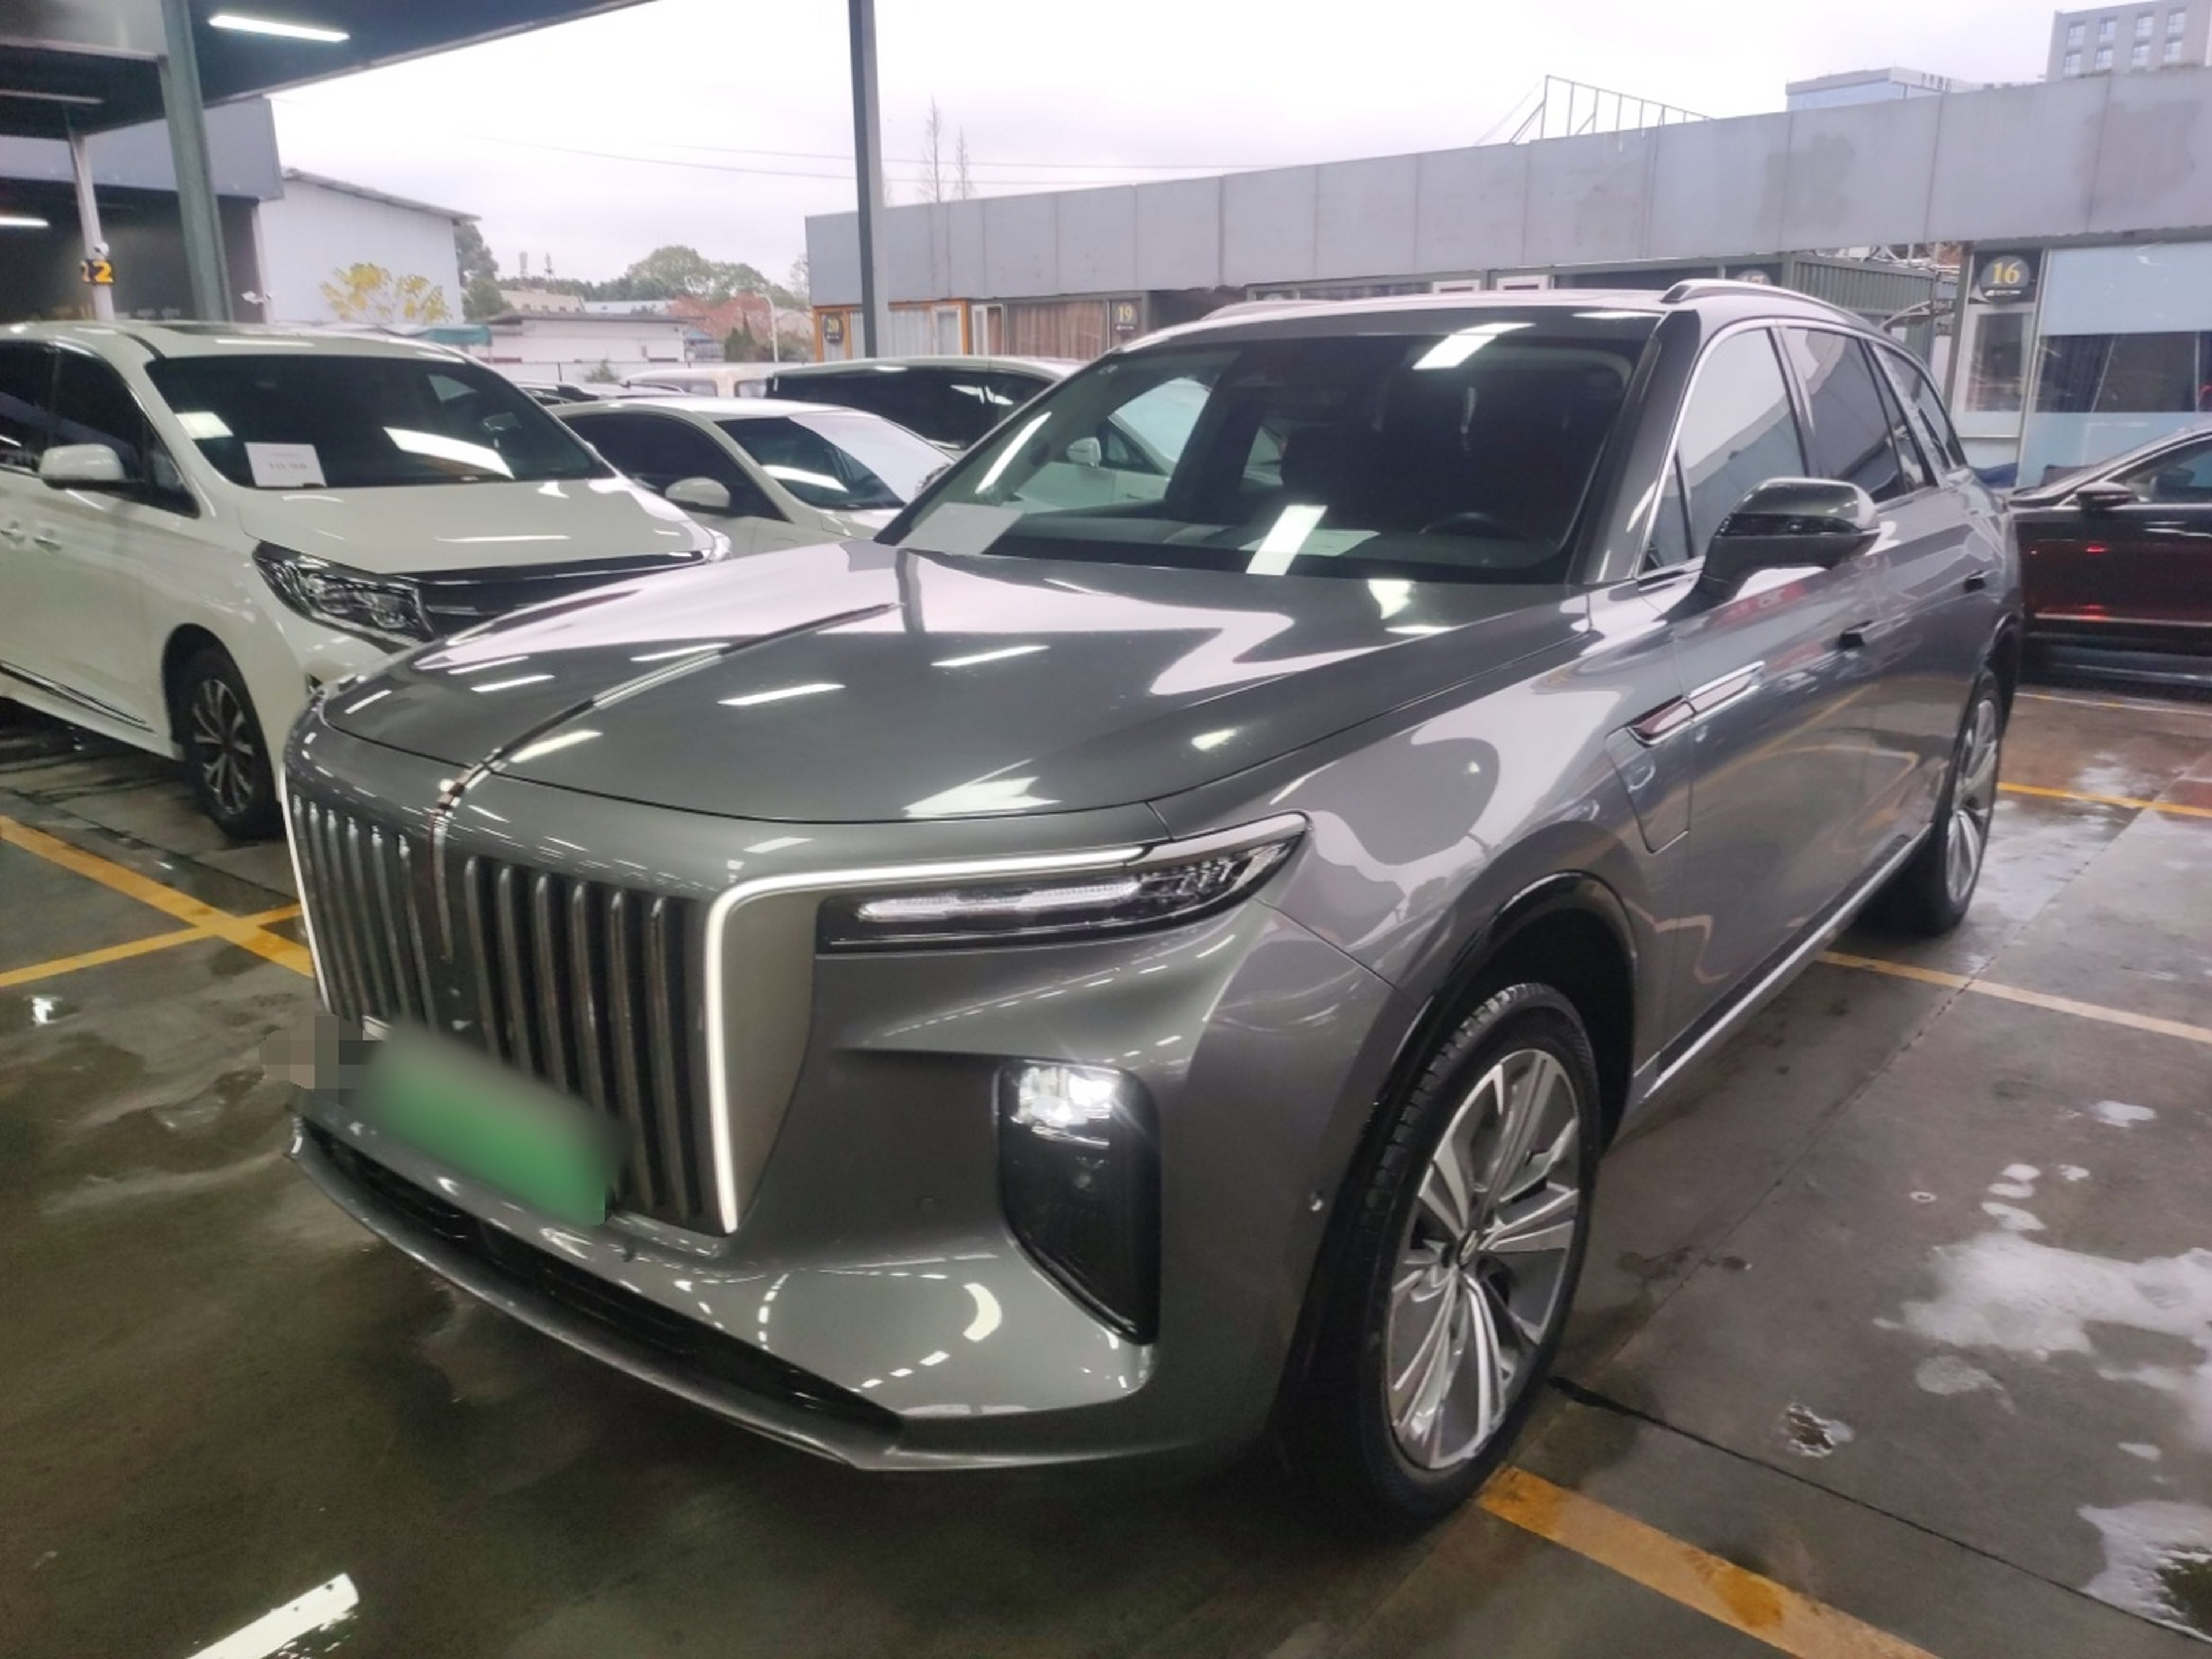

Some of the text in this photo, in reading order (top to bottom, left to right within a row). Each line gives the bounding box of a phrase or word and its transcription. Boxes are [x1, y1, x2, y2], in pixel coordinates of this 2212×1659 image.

[80, 259, 113, 283] 12
[1991, 261, 2021, 284] 16
[1119, 306, 1133, 323] 19
